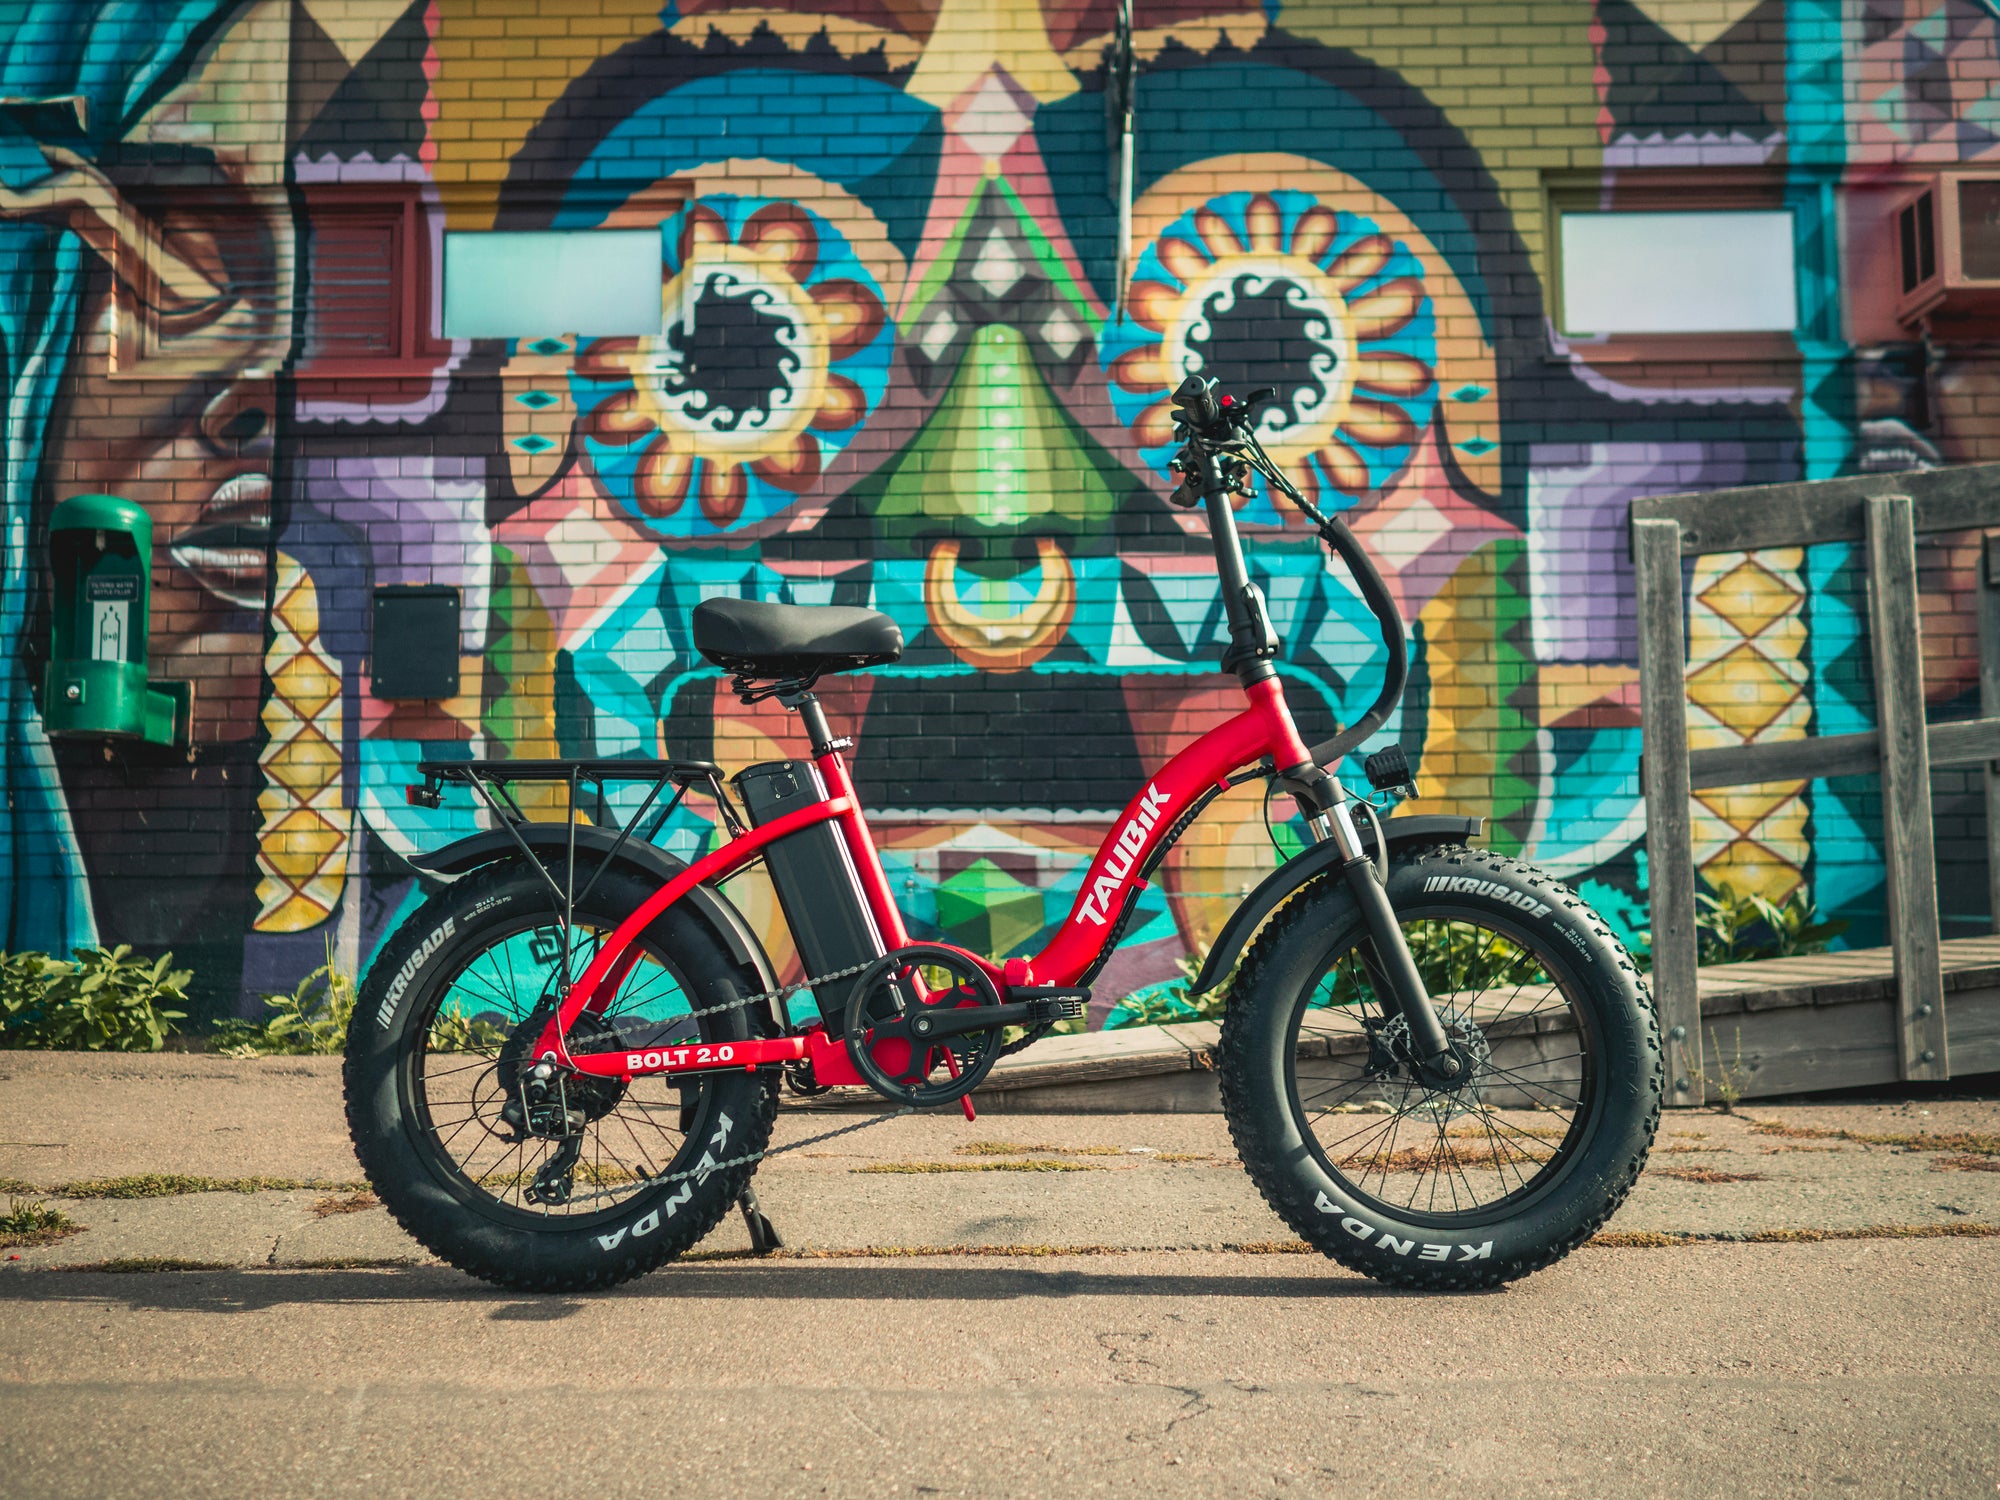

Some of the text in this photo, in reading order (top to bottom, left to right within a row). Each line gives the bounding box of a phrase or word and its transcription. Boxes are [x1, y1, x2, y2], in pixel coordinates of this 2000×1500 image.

[1445, 876, 1552, 919] KRUSADE
[385, 917, 456, 1009] KRUSADE
[626, 1045, 734, 1070] BOLT 2.0
[596, 1111, 734, 1251] KENDA
[1313, 1190, 1494, 1262] KENDA
